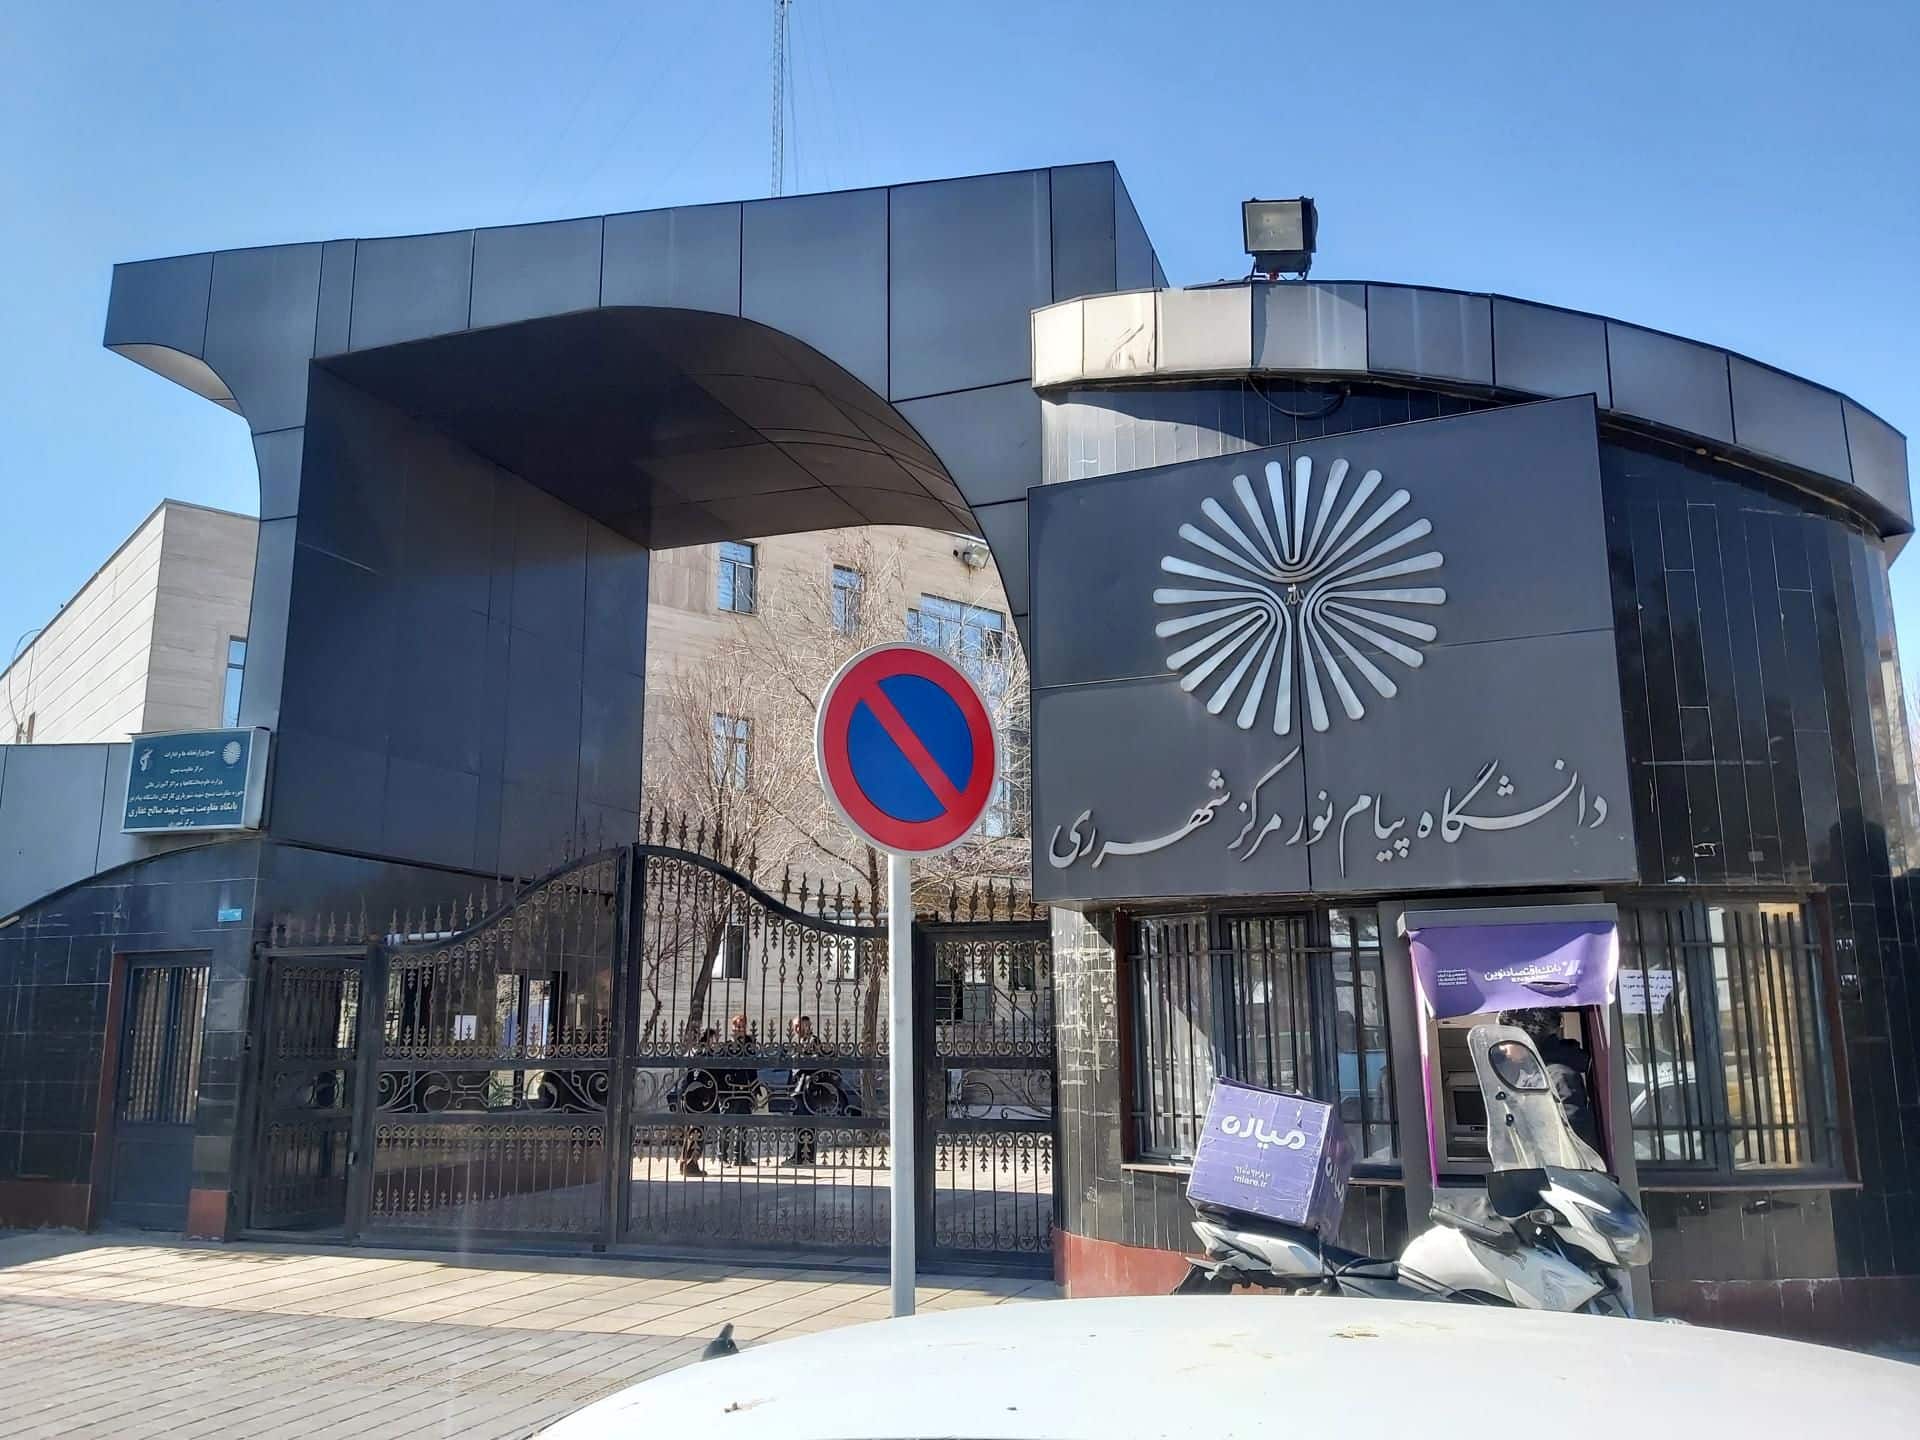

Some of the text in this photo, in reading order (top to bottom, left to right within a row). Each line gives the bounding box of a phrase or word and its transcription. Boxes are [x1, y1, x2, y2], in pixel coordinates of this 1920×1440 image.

[1228, 745, 1301, 862] مرکز
[1286, 789, 1335, 847] نور
[1339, 792, 1411, 879] پیام
[1417, 759, 1609, 843] دانشگاه
[1537, 963, 1562, 976] بانک
[1220, 1115, 1306, 1150] میاره
